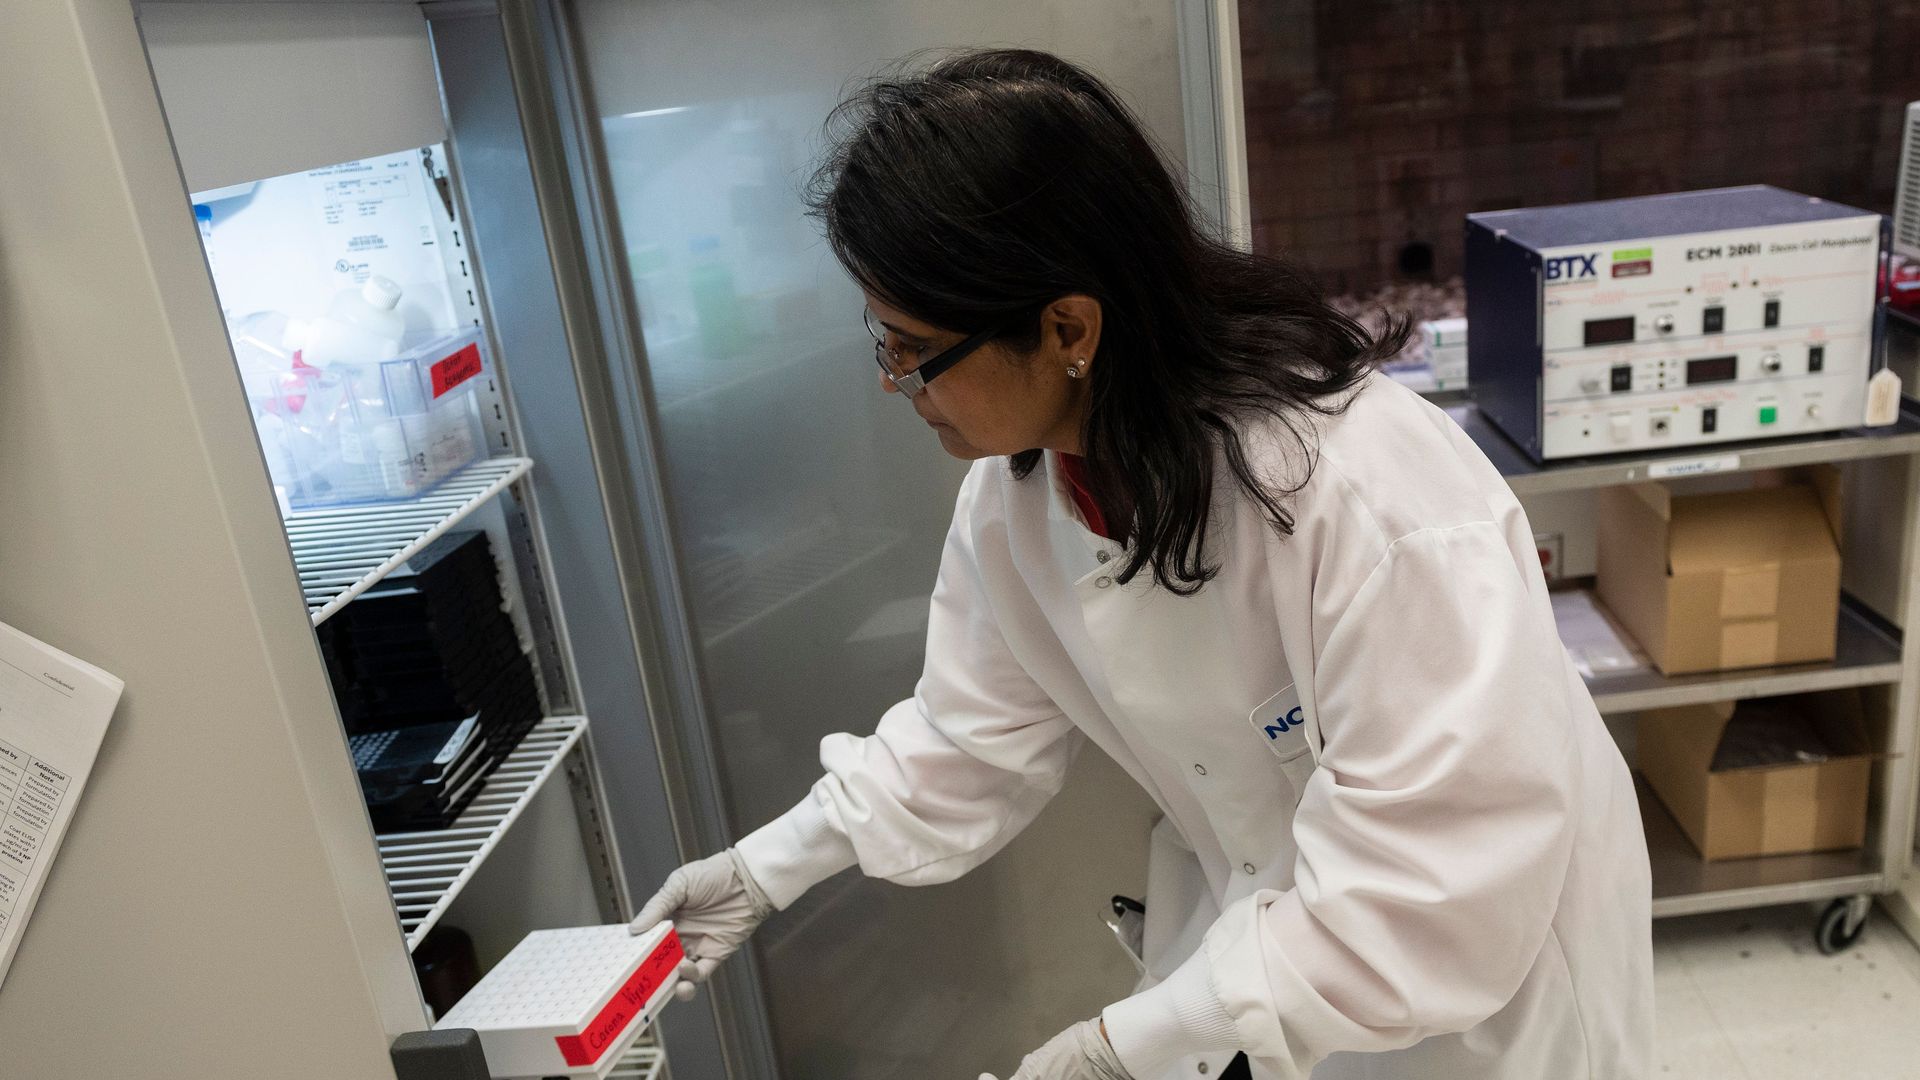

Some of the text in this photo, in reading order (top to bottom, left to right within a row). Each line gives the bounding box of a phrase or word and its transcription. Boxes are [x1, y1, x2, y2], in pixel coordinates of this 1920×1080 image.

[1686, 246, 1722, 262] ECM
[1727, 243, 1761, 258] 2001
[1546, 253, 1597, 280] BTX
[9, 751, 18, 760] by
[34, 762, 65, 781] Additional
[39, 772, 54, 783] Note
[25, 782, 56, 801] formulation
[28, 776, 59, 797] Prepared by
[19, 796, 50, 816] formulation
[22, 791, 54, 812] Prepared by
[13, 810, 43, 830] formulation
[17, 805, 48, 826] Prepared by
[3, 829, 20, 841] plates
[20, 838, 32, 848] with
[9, 824, 36, 842] Coat ELISA
[1, 850, 23, 864] proteins
[588, 1012, 626, 1049] Corona
